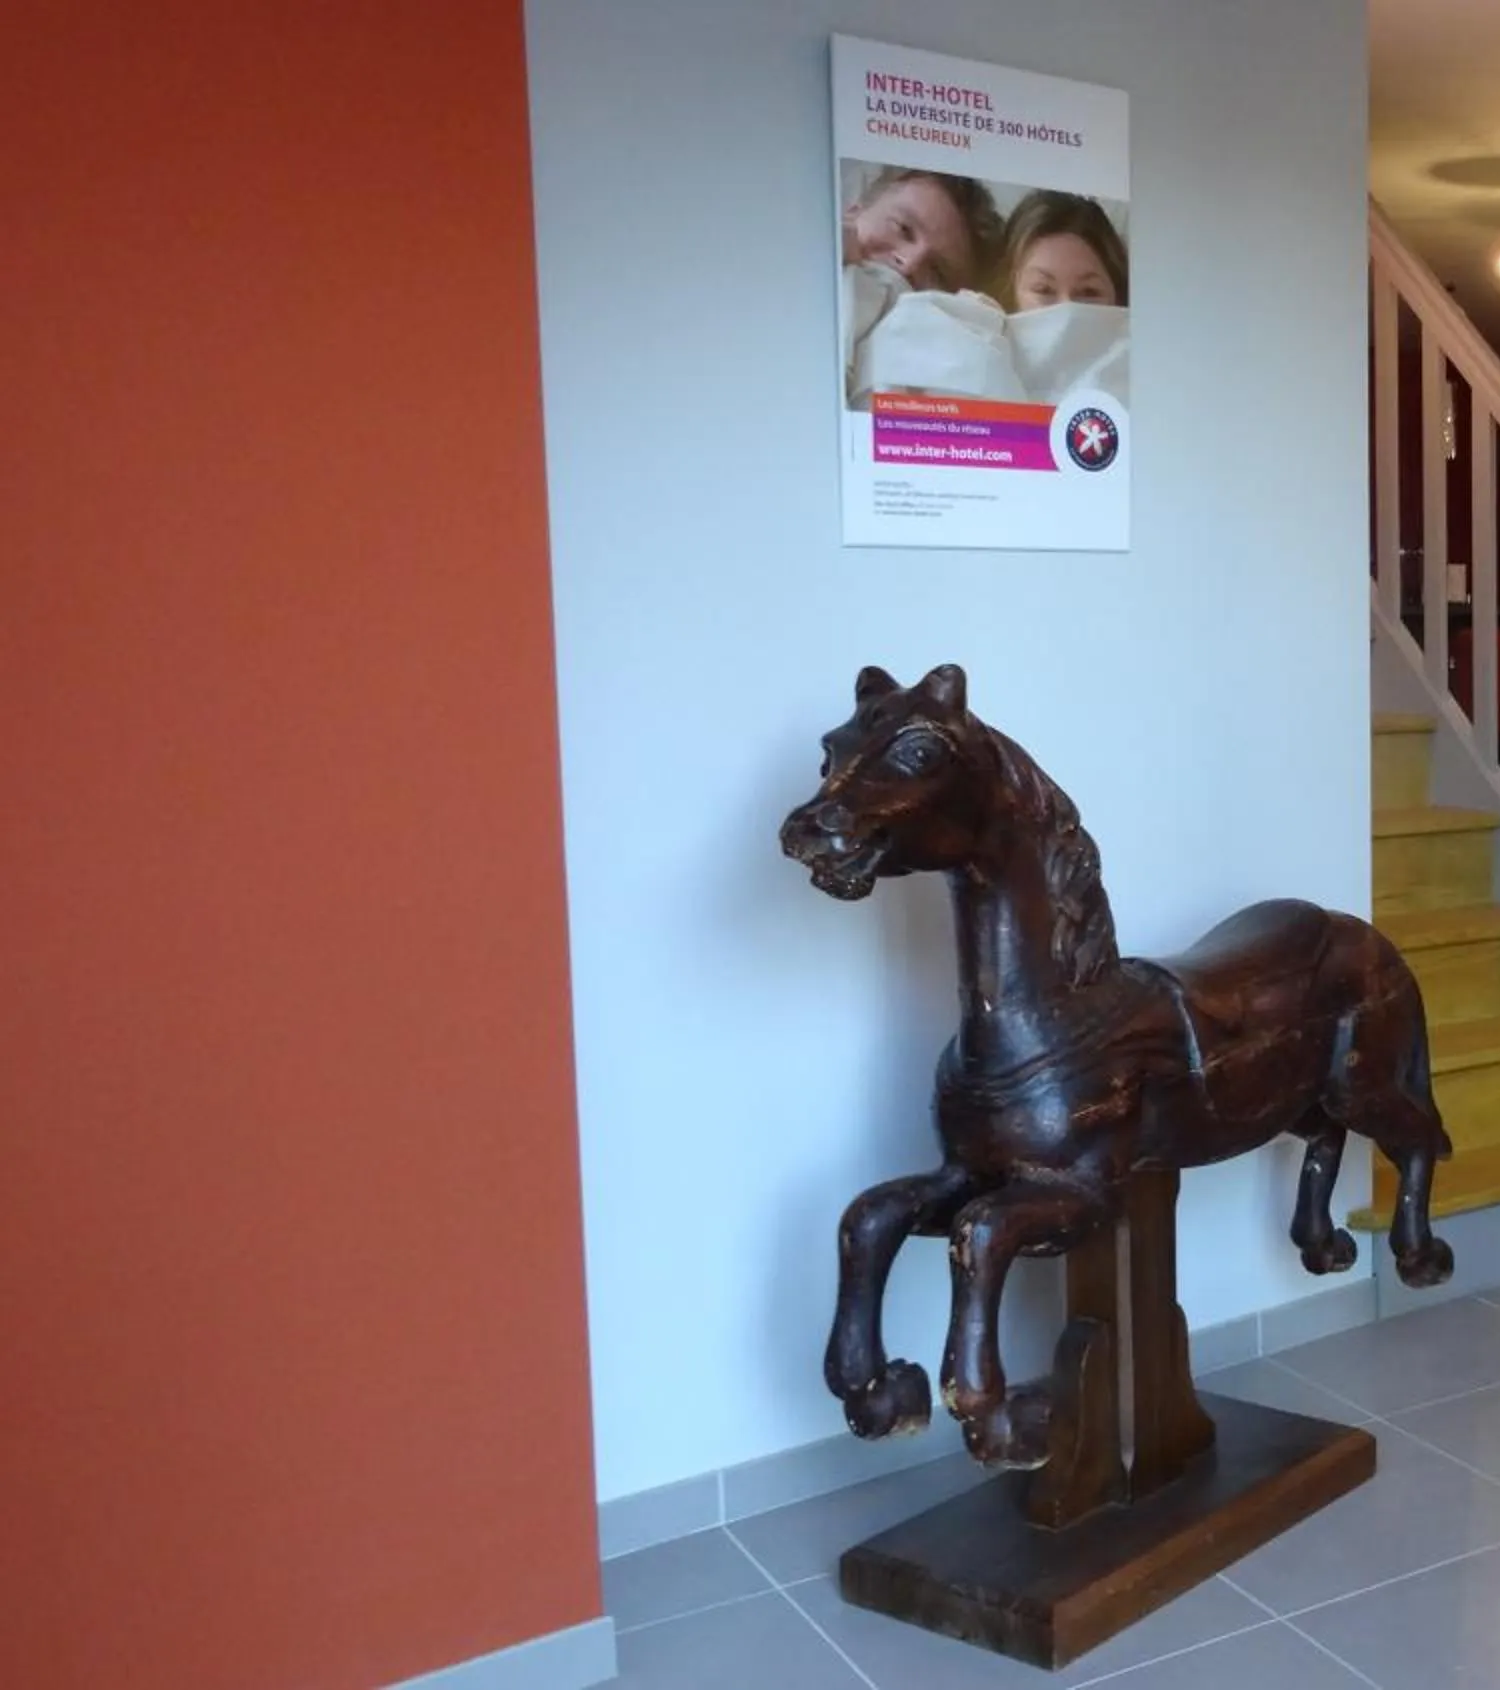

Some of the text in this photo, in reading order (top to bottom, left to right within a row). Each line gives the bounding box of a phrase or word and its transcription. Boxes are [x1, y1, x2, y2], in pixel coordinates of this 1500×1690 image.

[865, 70, 994, 112] INTER-HOTEL
[866, 95, 887, 113] LA
[975, 114, 994, 133] DE
[997, 119, 1024, 138] 300
[1026, 122, 1083, 148] HÔTELS
[866, 117, 972, 149] CHALEUREUX
[877, 399, 893, 409] Les
[877, 418, 894, 429] Les
[947, 421, 960, 433] du
[877, 442, 1013, 463] www.inter-hotel.com
